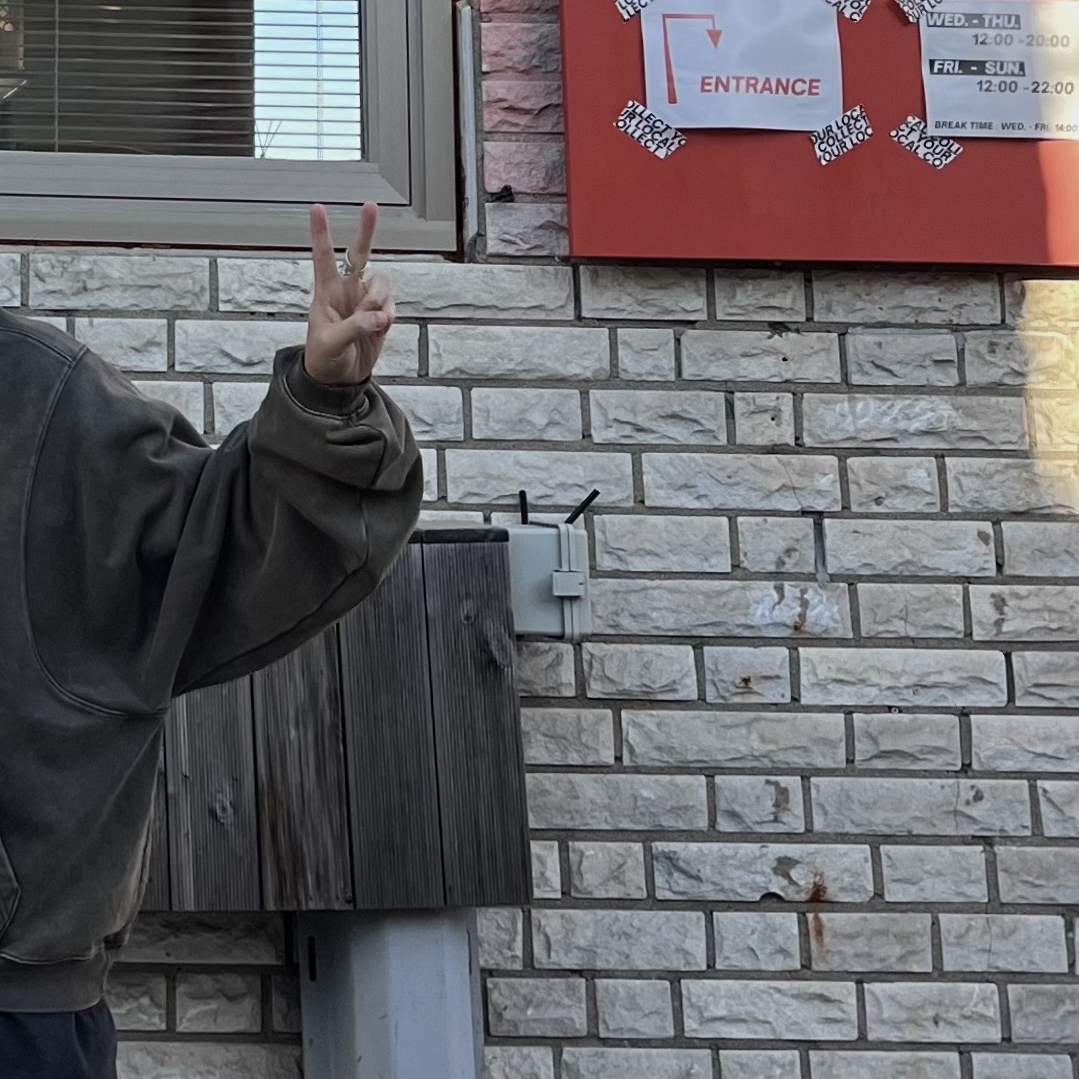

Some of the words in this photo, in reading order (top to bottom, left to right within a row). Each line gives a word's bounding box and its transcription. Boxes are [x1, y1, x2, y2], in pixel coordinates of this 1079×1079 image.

[927, 13, 969, 27] WED.
[982, 14, 1019, 28] THU.
[972, 33, 1014, 46] 12:00
[1026, 34, 1070, 48] 20:00
[933, 60, 963, 74] FRI.
[985, 61, 1023, 75] SUN.
[700, 75, 821, 96] ENTRANCE
[976, 80, 1018, 93] 12:00
[1031, 81, 1075, 95] 22:00
[934, 120, 968, 130] BREAK
[970, 121, 994, 130] TIME
